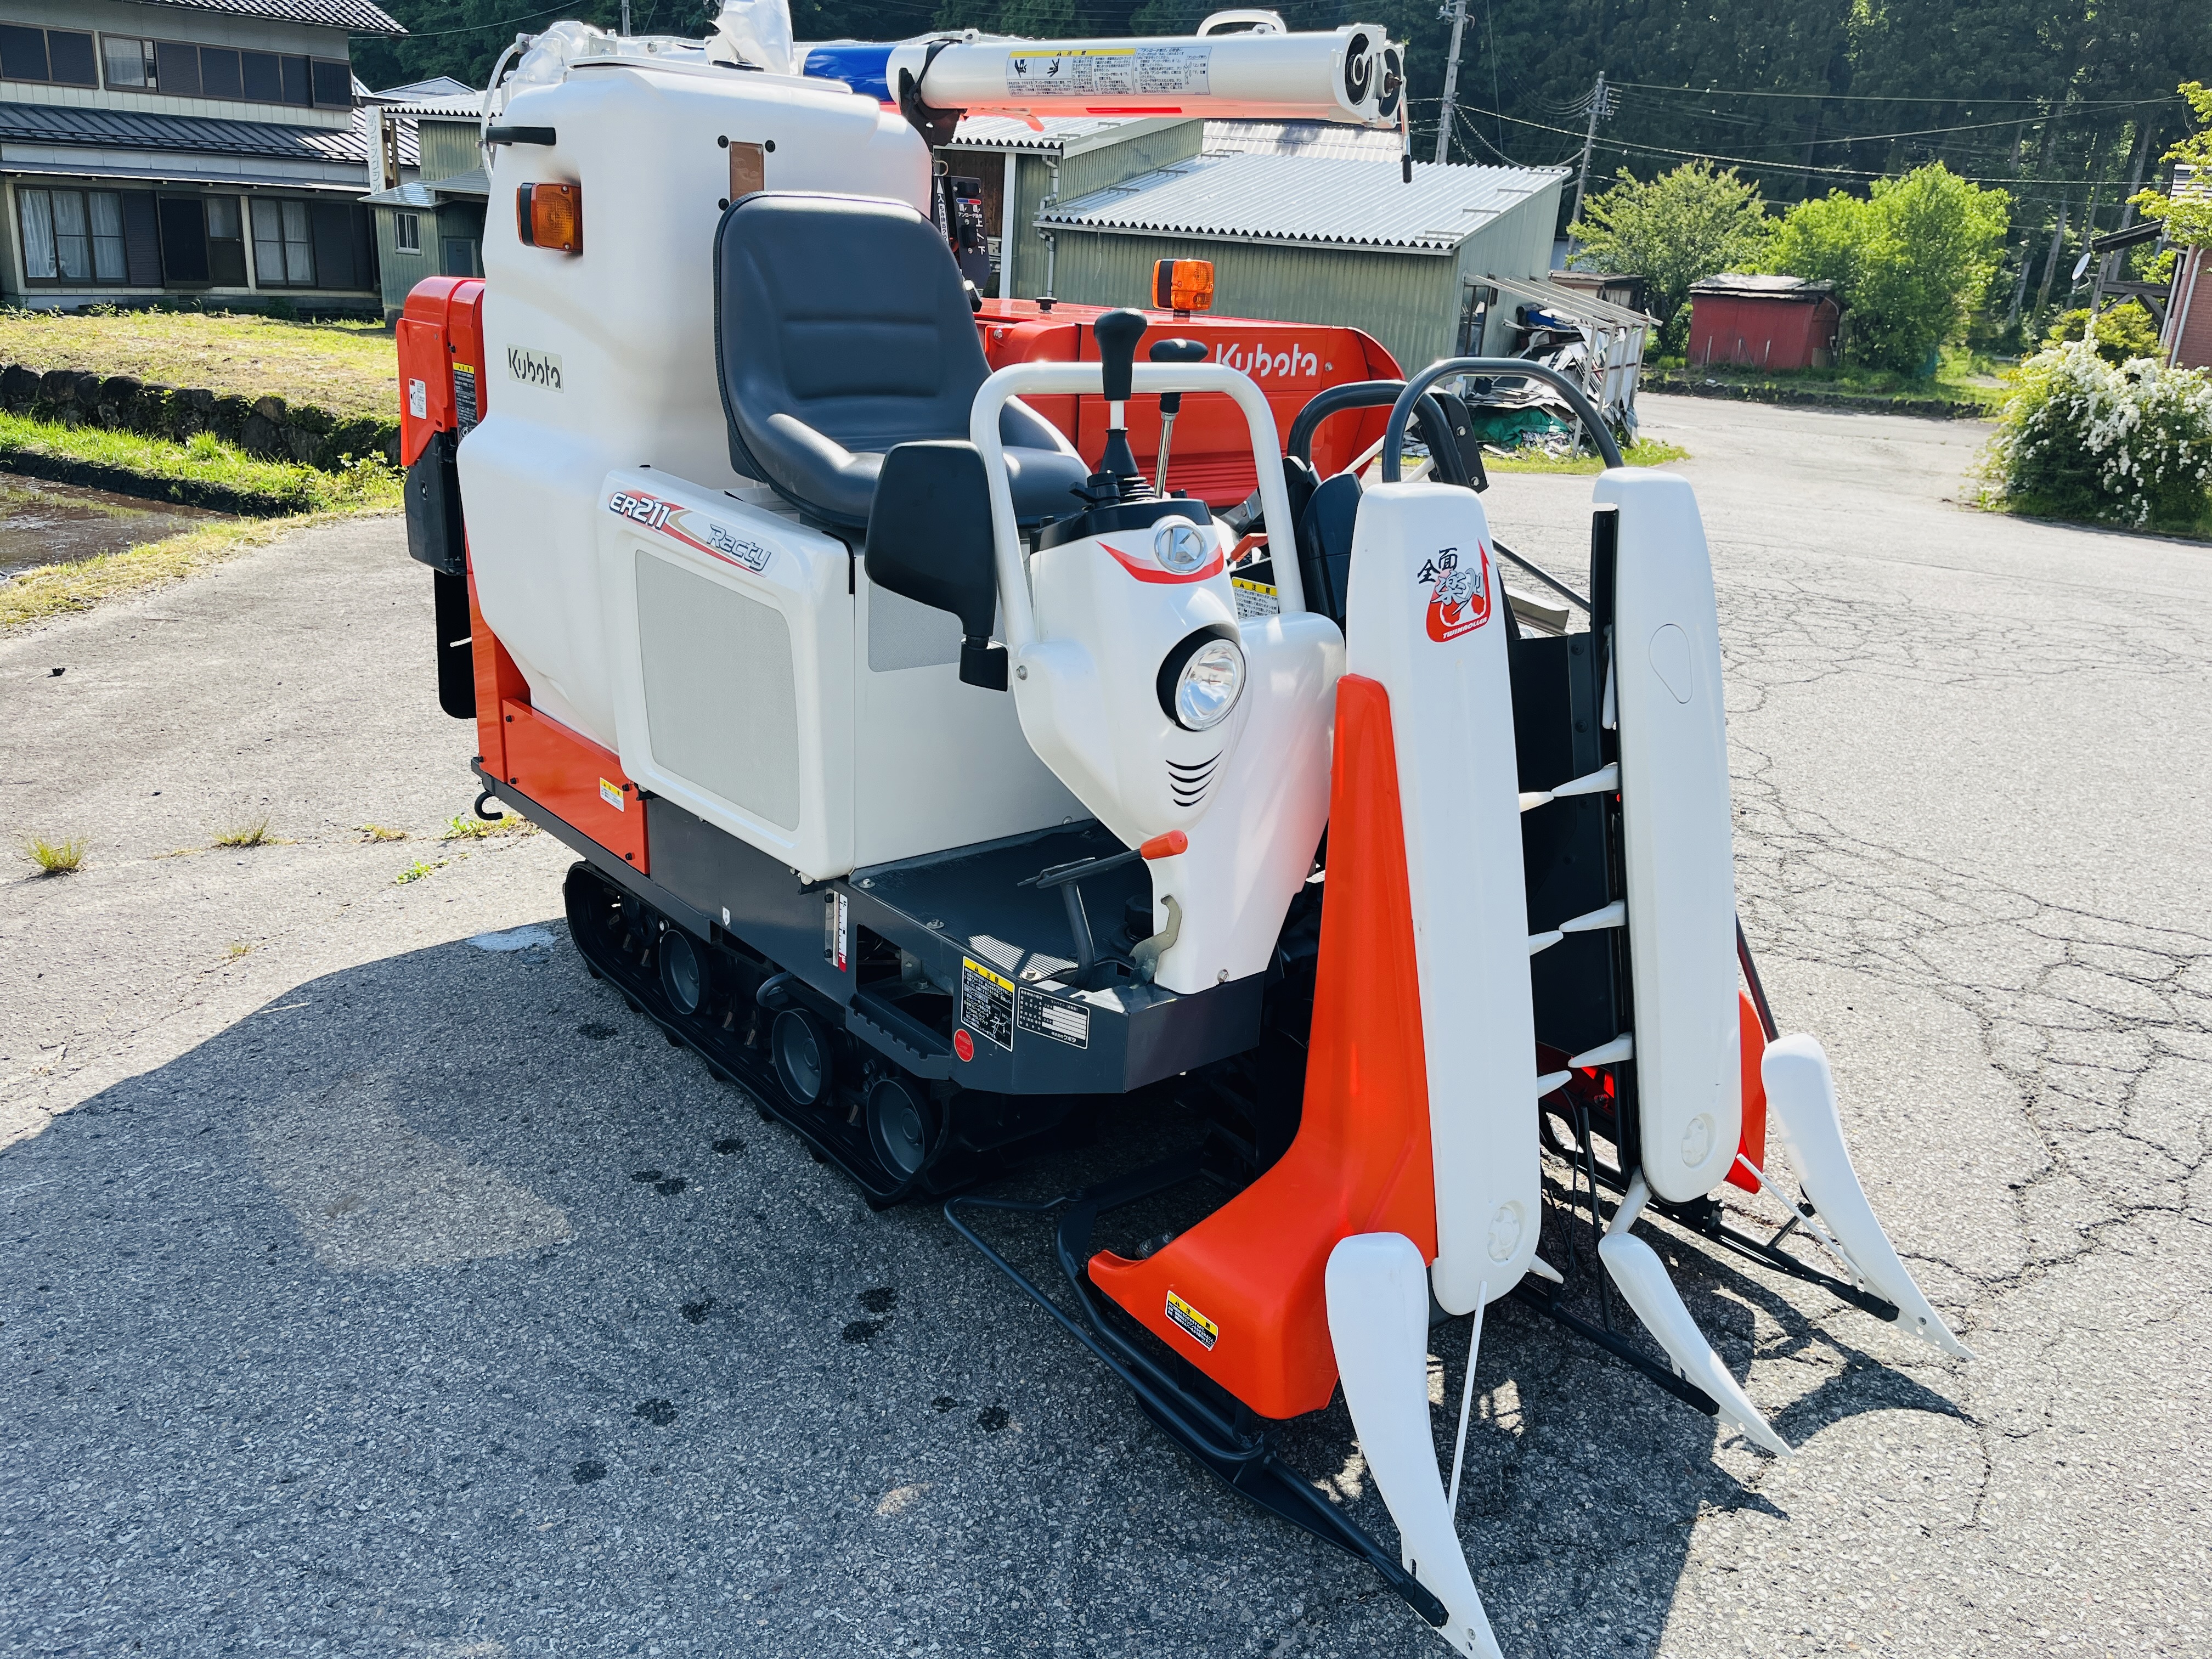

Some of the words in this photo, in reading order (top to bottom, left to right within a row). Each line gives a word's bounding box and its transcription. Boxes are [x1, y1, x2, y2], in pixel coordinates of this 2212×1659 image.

[976, 218, 983, 227] 上
[978, 246, 985, 255] 下
[508, 348, 561, 388] Kubota
[1216, 343, 1317, 377] Kubota
[609, 492, 670, 531] ER211
[707, 524, 771, 571] Racty
[1443, 617, 1487, 639] TWINROLLER
[986, 971, 999, 984] 注意
